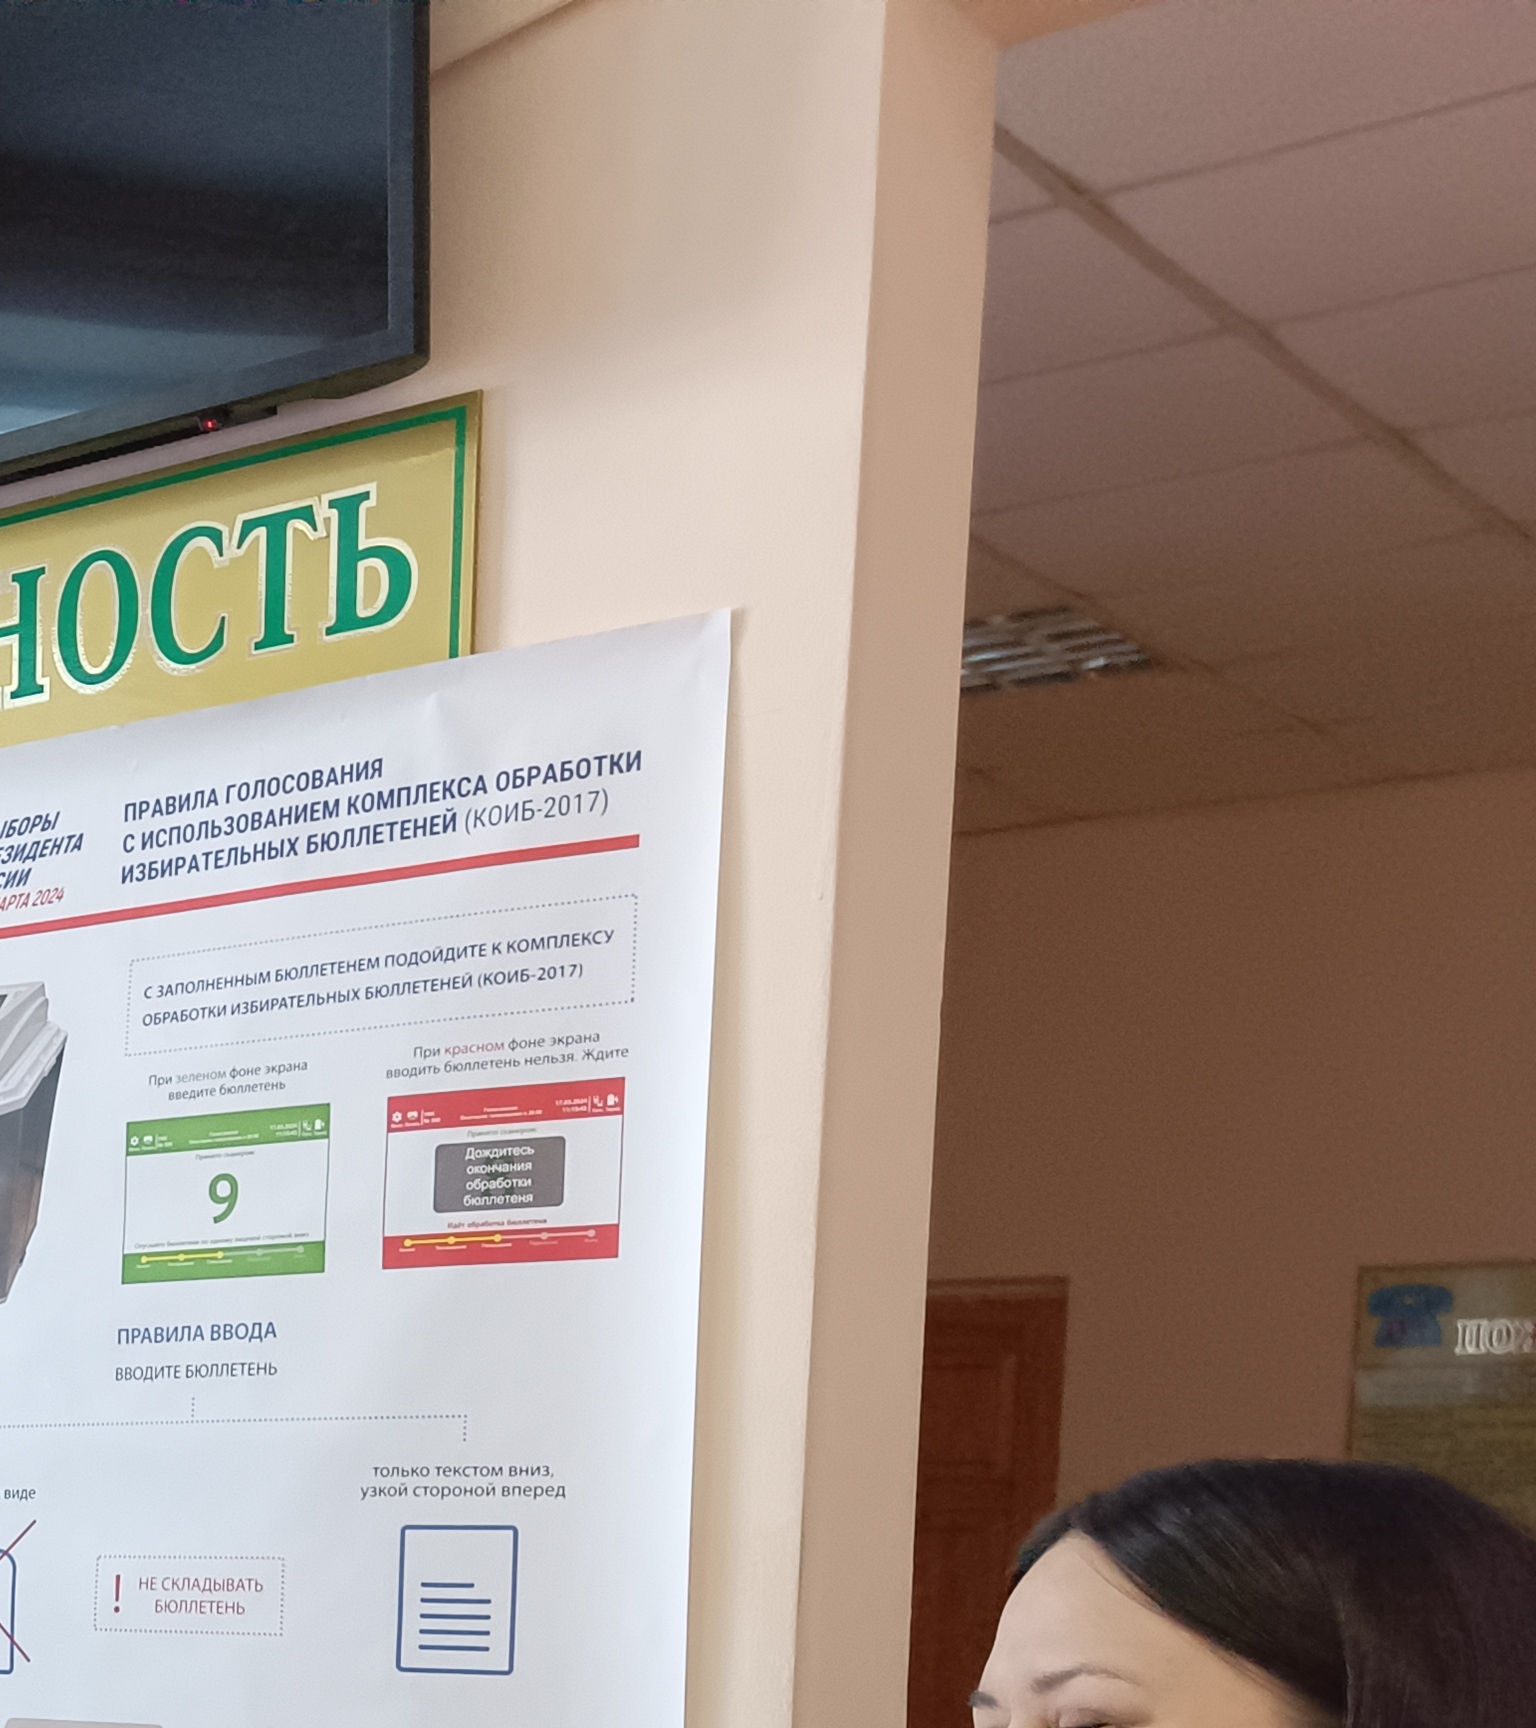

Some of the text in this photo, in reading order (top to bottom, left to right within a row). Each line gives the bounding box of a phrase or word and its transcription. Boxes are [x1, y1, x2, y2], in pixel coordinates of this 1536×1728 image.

[123, 757, 383, 822] ПРАВИЛА ГОЛОСОВАНИЯ
[123, 749, 642, 853] С ИСПОЛЬЗОВАНИЕМ КОМПЛЕКСА ОБРАБОТКИ
[121, 787, 609, 884] ИЗБИРАТЕЛЬНЫХ БЮЛЛЕТЕНЕЙ (КОИБ-2017)
[31, 887, 65, 907] 2024
[143, 929, 615, 999] С ЗАПОЛНЕННЫМ БЮЛЛЕТЕНЕМ ПОДОЙДИТЕ К КОМПЛЕКСУ
[142, 963, 584, 1027] ОБРАБОТКИ ИЗБИРАТЕЛЬНЫХ БЮЛЛЕТЕНЕЙ (КОИБ-2017)
[413, 1032, 600, 1060] При красном фоне экрана
[386, 1046, 629, 1079] вводить бюллетень нельзя. Ждите
[148, 1061, 308, 1087] При зеленом фоне экрана
[168, 1081, 286, 1101] введите бюллетень
[465, 1144, 535, 1161] Дождитесь
[466, 1161, 532, 1175] окончания
[466, 1177, 532, 1191] обработки
[208, 1173, 239, 1224] 9
[463, 1193, 534, 1207] бюллетеня
[117, 1321, 277, 1345] ПРАВИЛА ВВОДА
[115, 1361, 278, 1382] ВВОДИТЕ БЮЛЛЕТЕНЬ
[373, 1465, 555, 1479] только текстом вниз,
[4, 1488, 37, 1501] виде
[360, 1482, 566, 1501] узкой стороной вперед
[138, 1576, 264, 1593] НЕ СКЛАДЫВАТЬ
[154, 1599, 246, 1615] БЮЛЛЕТЕНЬ
